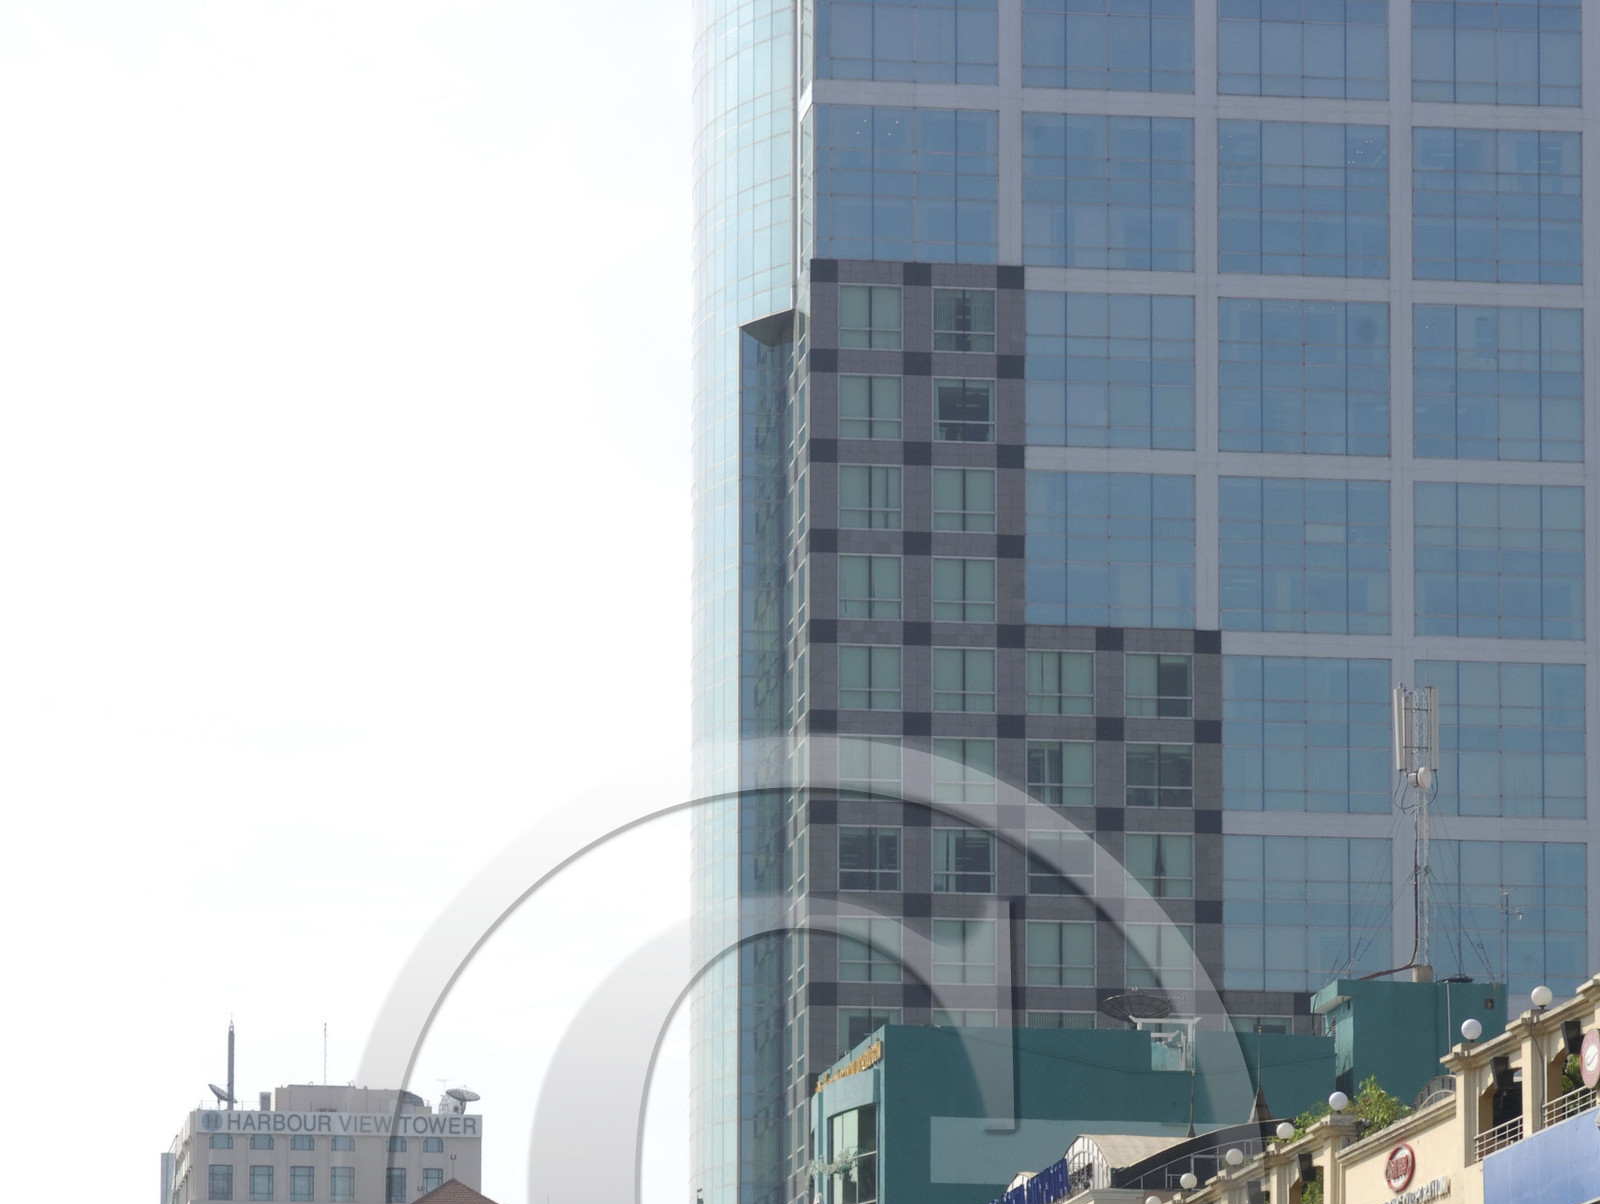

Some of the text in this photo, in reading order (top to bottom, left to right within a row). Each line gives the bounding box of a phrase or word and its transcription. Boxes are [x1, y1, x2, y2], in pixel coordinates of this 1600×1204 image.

[227, 1114, 331, 1132] HARBOUR
[339, 1115, 393, 1133] VIEW
[399, 1116, 477, 1135] TOWER
